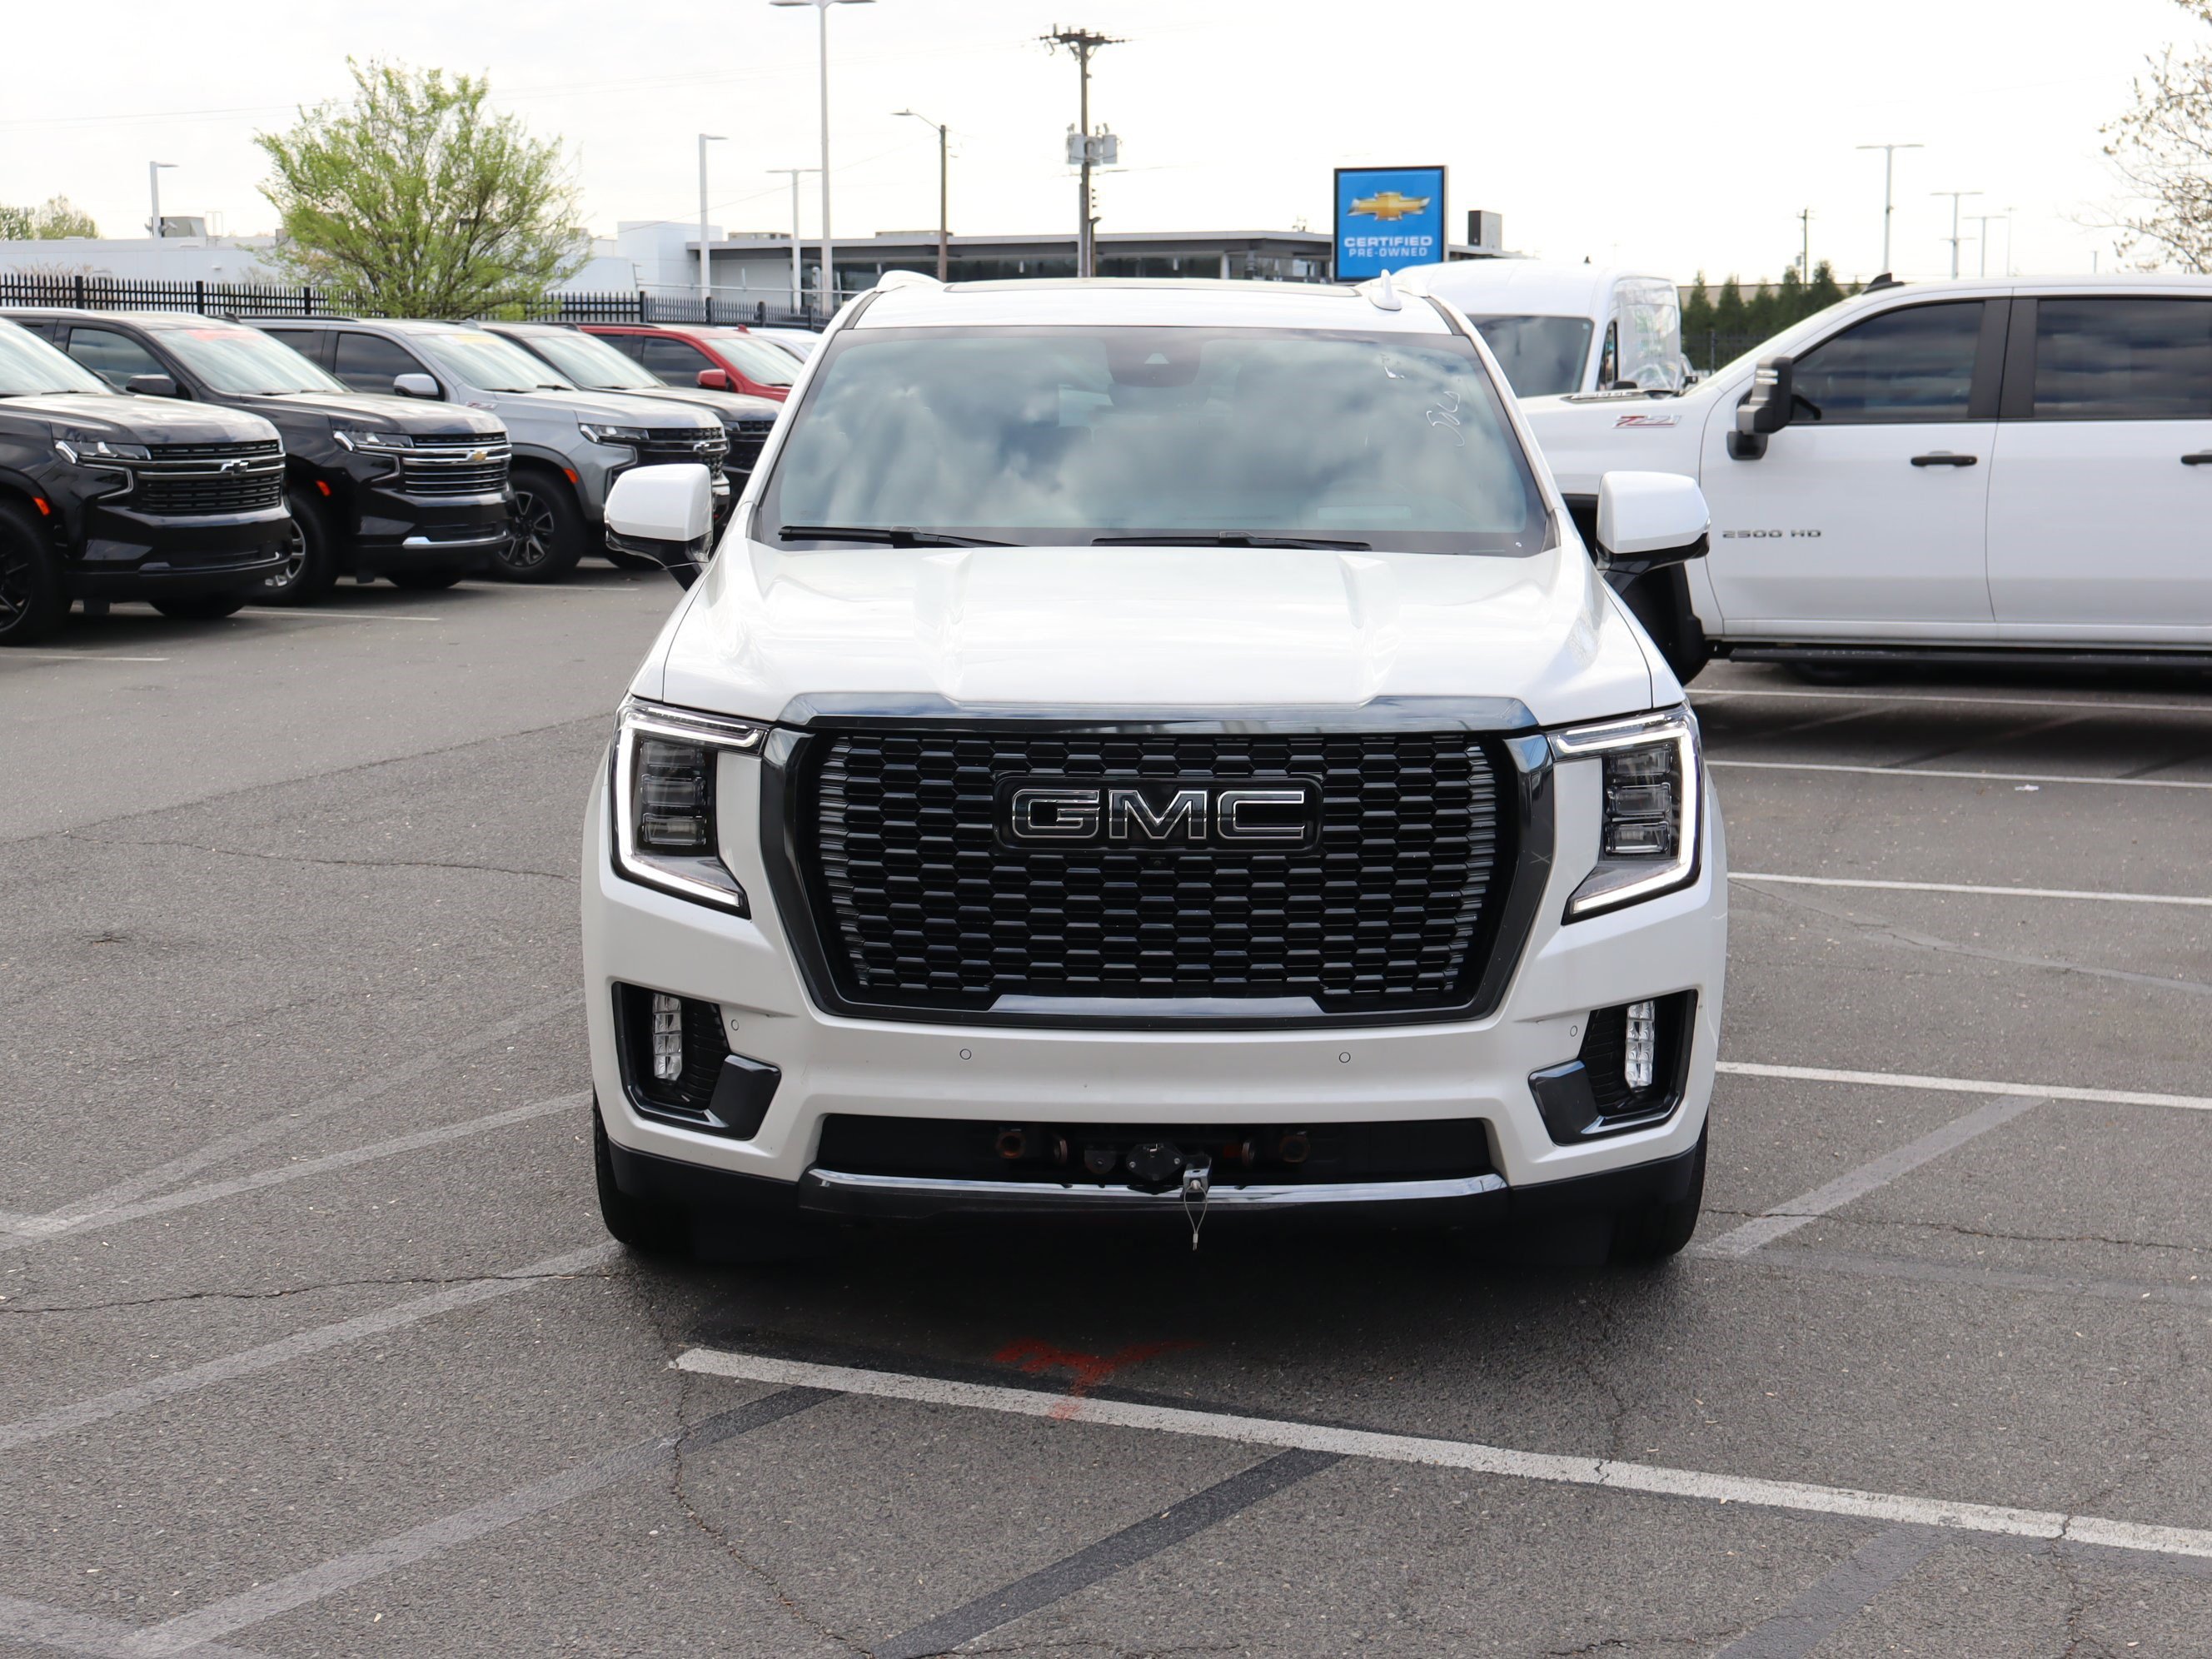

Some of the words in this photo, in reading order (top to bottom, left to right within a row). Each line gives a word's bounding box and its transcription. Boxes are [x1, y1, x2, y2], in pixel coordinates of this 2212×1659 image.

[1343, 235, 1433, 247] CERTIFIED
[1348, 247, 1428, 257] PRE-OWNED
[1722, 530, 1782, 538] 2500
[1791, 530, 1821, 538] HD
[1012, 789, 1305, 840] GMC
